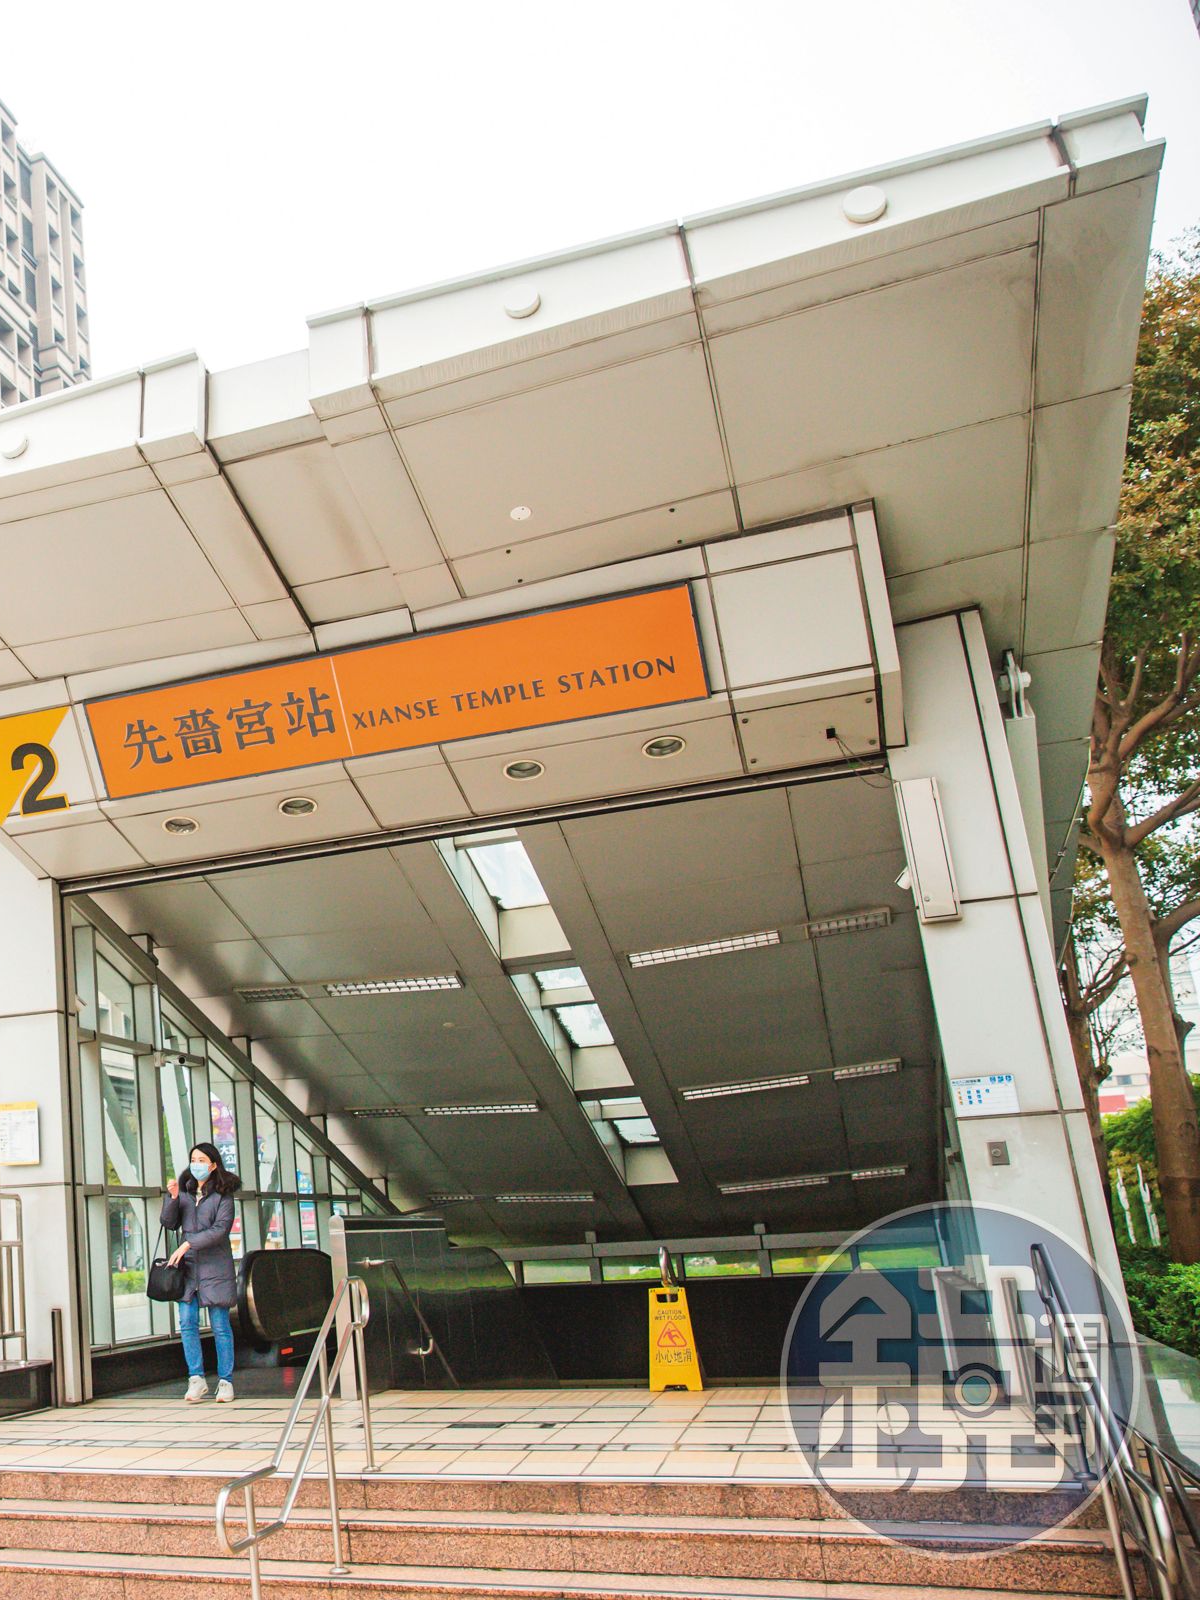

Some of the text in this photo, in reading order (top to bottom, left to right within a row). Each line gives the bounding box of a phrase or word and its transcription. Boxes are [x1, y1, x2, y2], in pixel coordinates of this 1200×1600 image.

[122, 686, 337, 769] 先嗇宮站
[352, 655, 677, 731] XIANSE TEMPLE STATION
[11, 742, 67, 815] 2
[656, 1348, 692, 1363] 小心地滑
